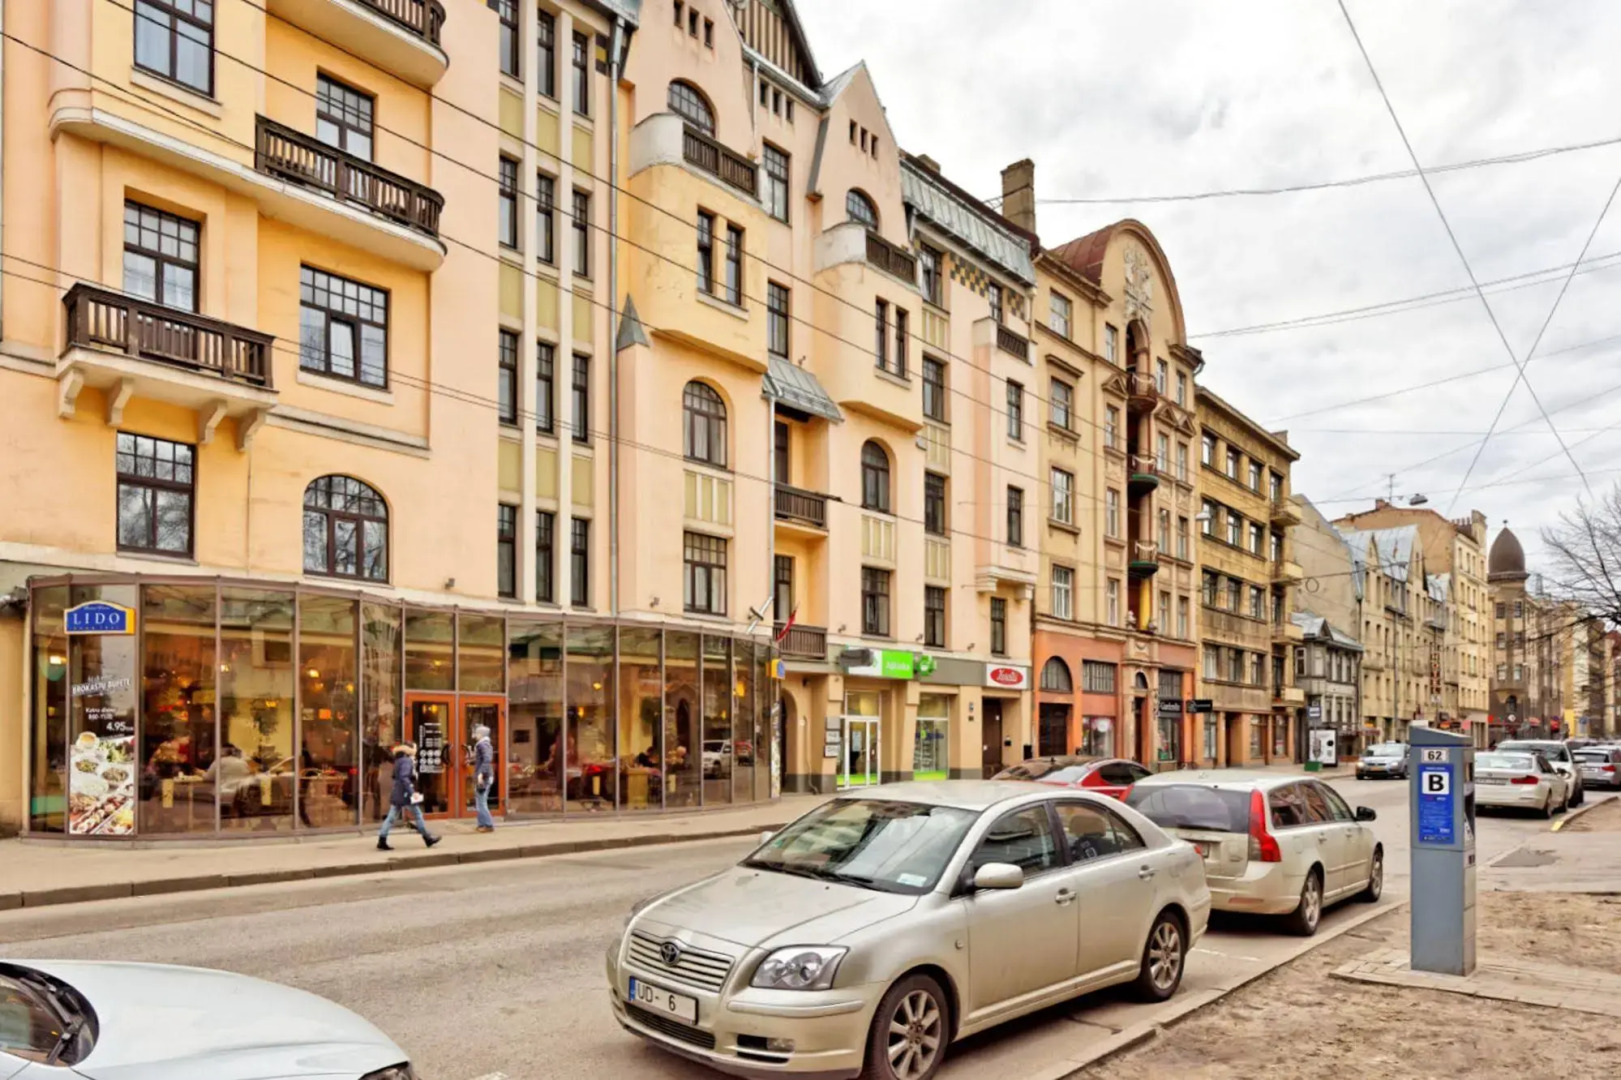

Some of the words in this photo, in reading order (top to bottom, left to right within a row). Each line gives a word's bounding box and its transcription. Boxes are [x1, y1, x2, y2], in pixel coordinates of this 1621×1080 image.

[73, 612, 120, 625] LIDO
[1427, 750, 1442, 761] 62
[1428, 774, 1444, 792] B
[668, 994, 676, 1011] 6
